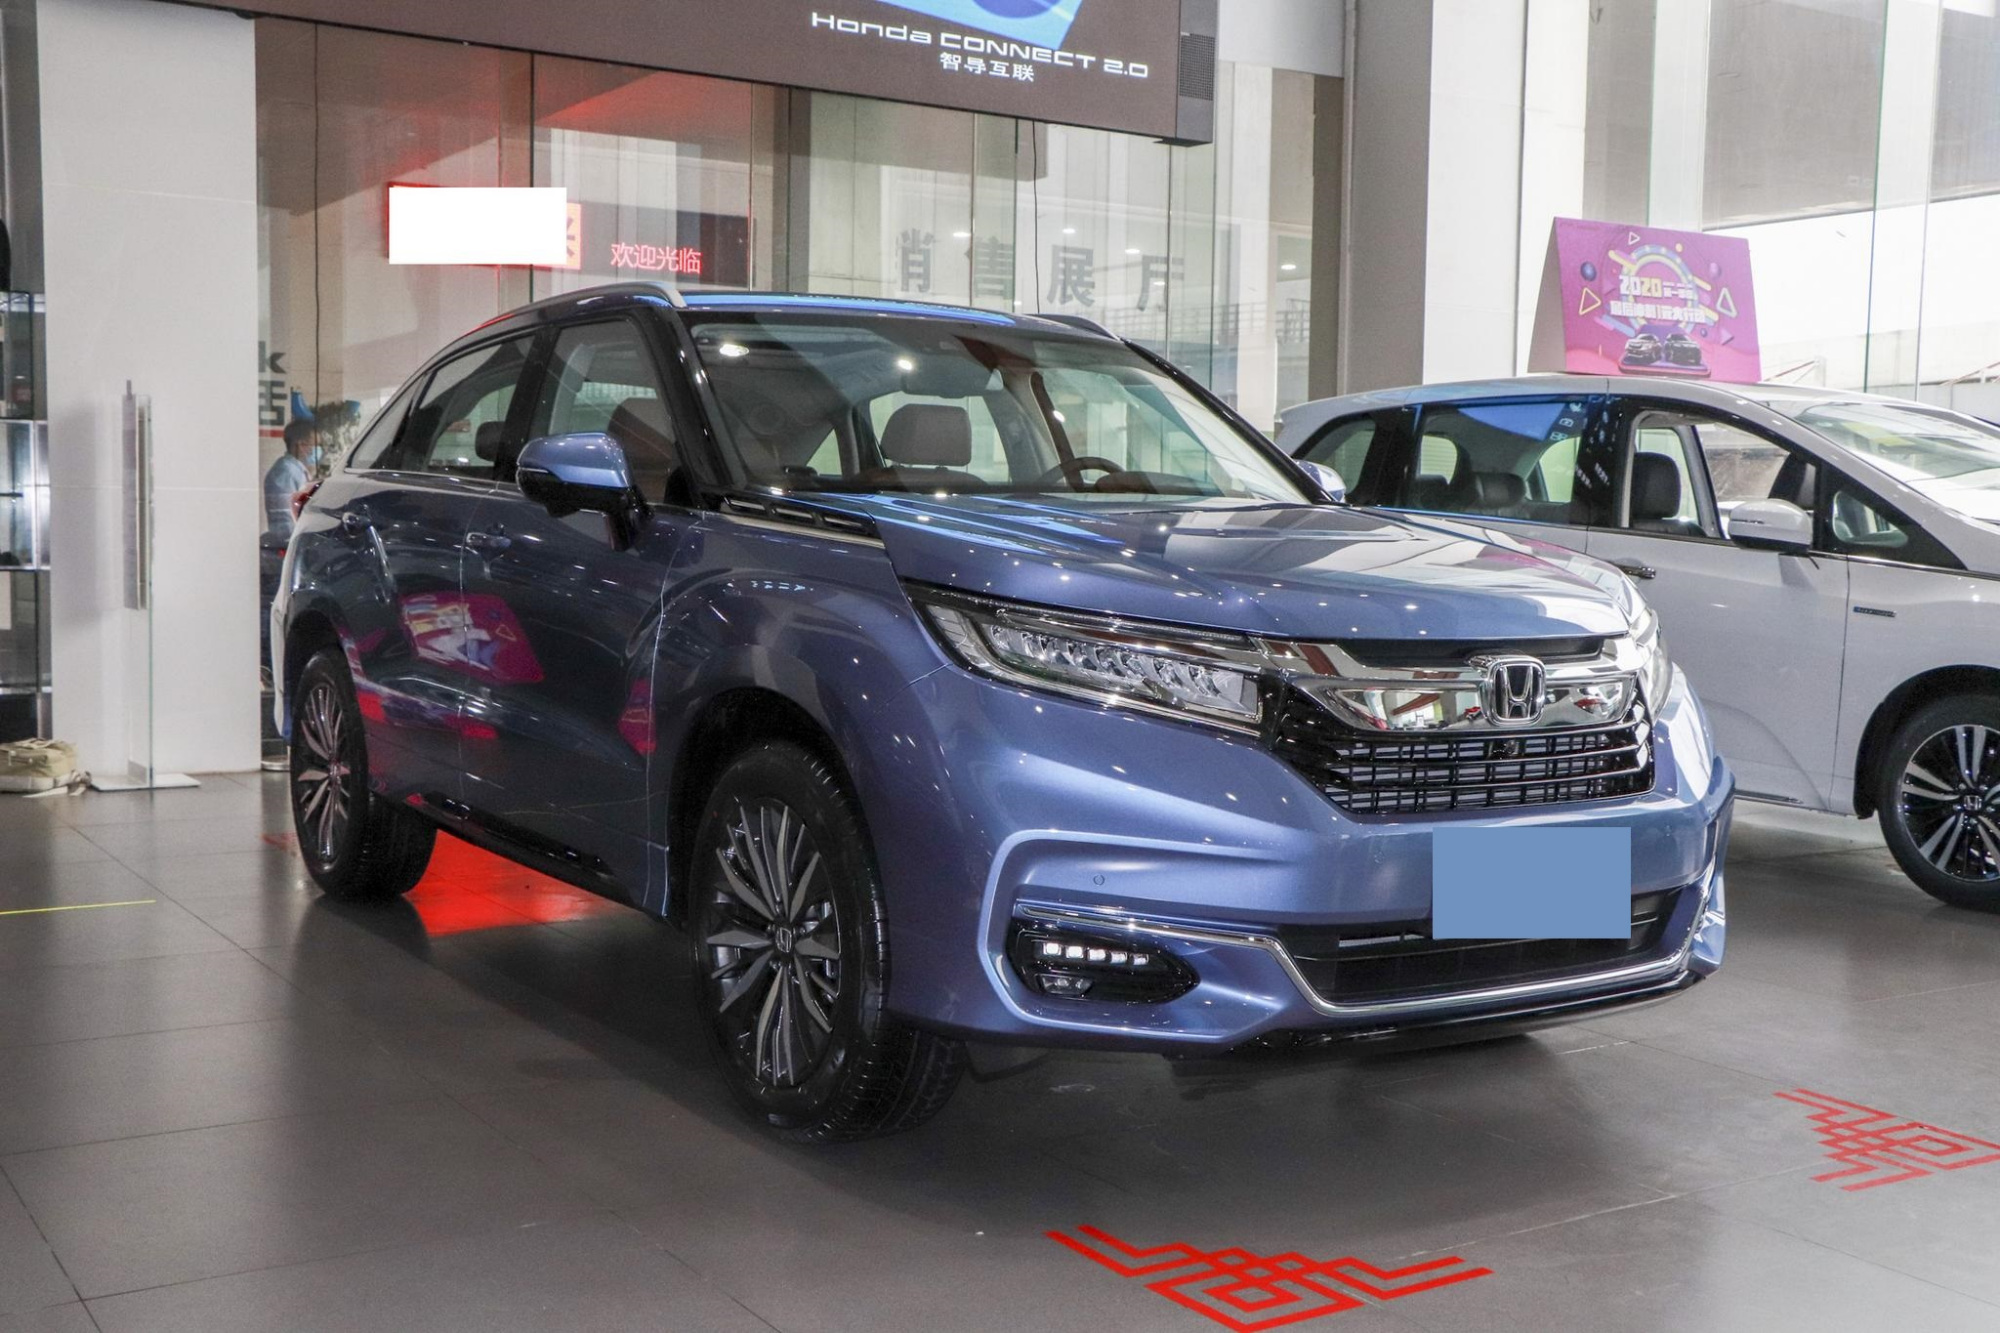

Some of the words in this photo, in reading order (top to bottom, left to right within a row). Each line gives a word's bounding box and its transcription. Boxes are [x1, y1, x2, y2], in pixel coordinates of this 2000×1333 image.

[812, 11, 932, 44] Honda
[940, 32, 1096, 69] CONNECT
[1103, 58, 1148, 78] 2.0
[939, 51, 1035, 82] 智导互联
[610, 242, 702, 274] 欢迎光临
[1619, 274, 1662, 298] 2020
